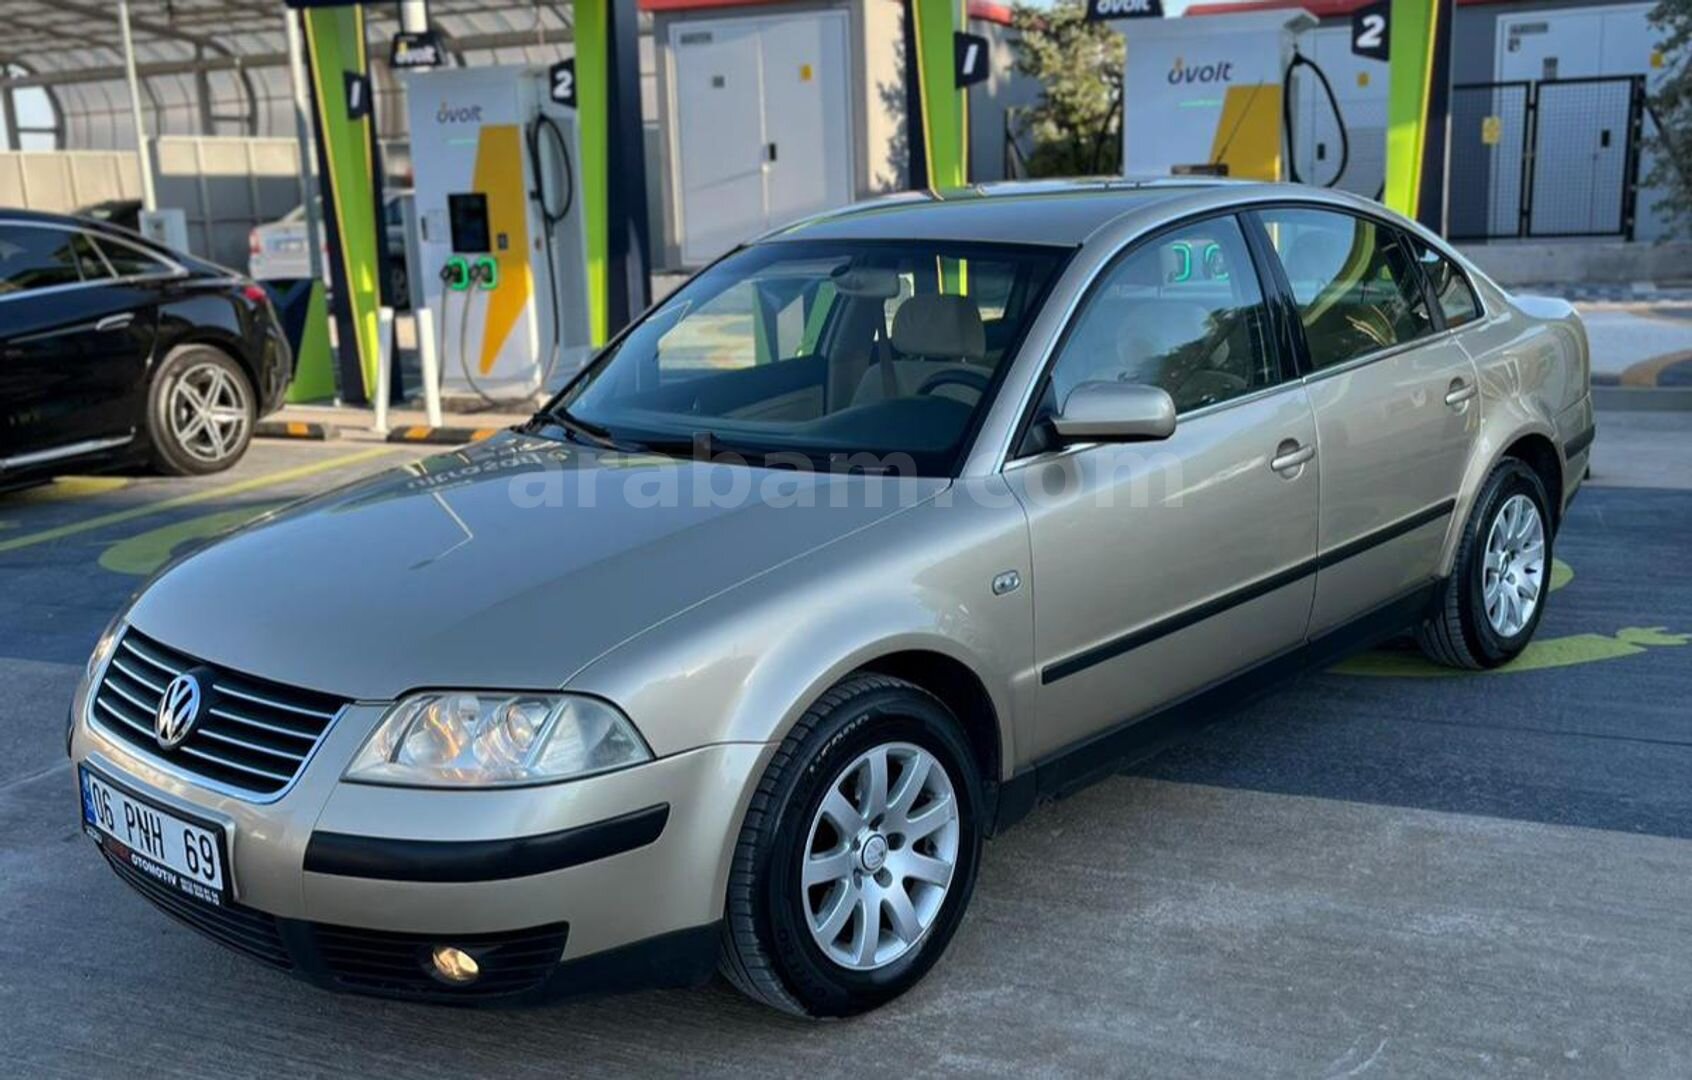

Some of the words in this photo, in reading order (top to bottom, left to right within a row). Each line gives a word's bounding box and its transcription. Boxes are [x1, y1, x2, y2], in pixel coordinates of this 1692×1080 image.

[1355, 15, 1386, 48] 2
[961, 43, 978, 75] 1
[552, 70, 574, 98] 2
[92, 782, 115, 832] 06
[123, 801, 166, 860] PNH
[183, 828, 216, 881] 69
